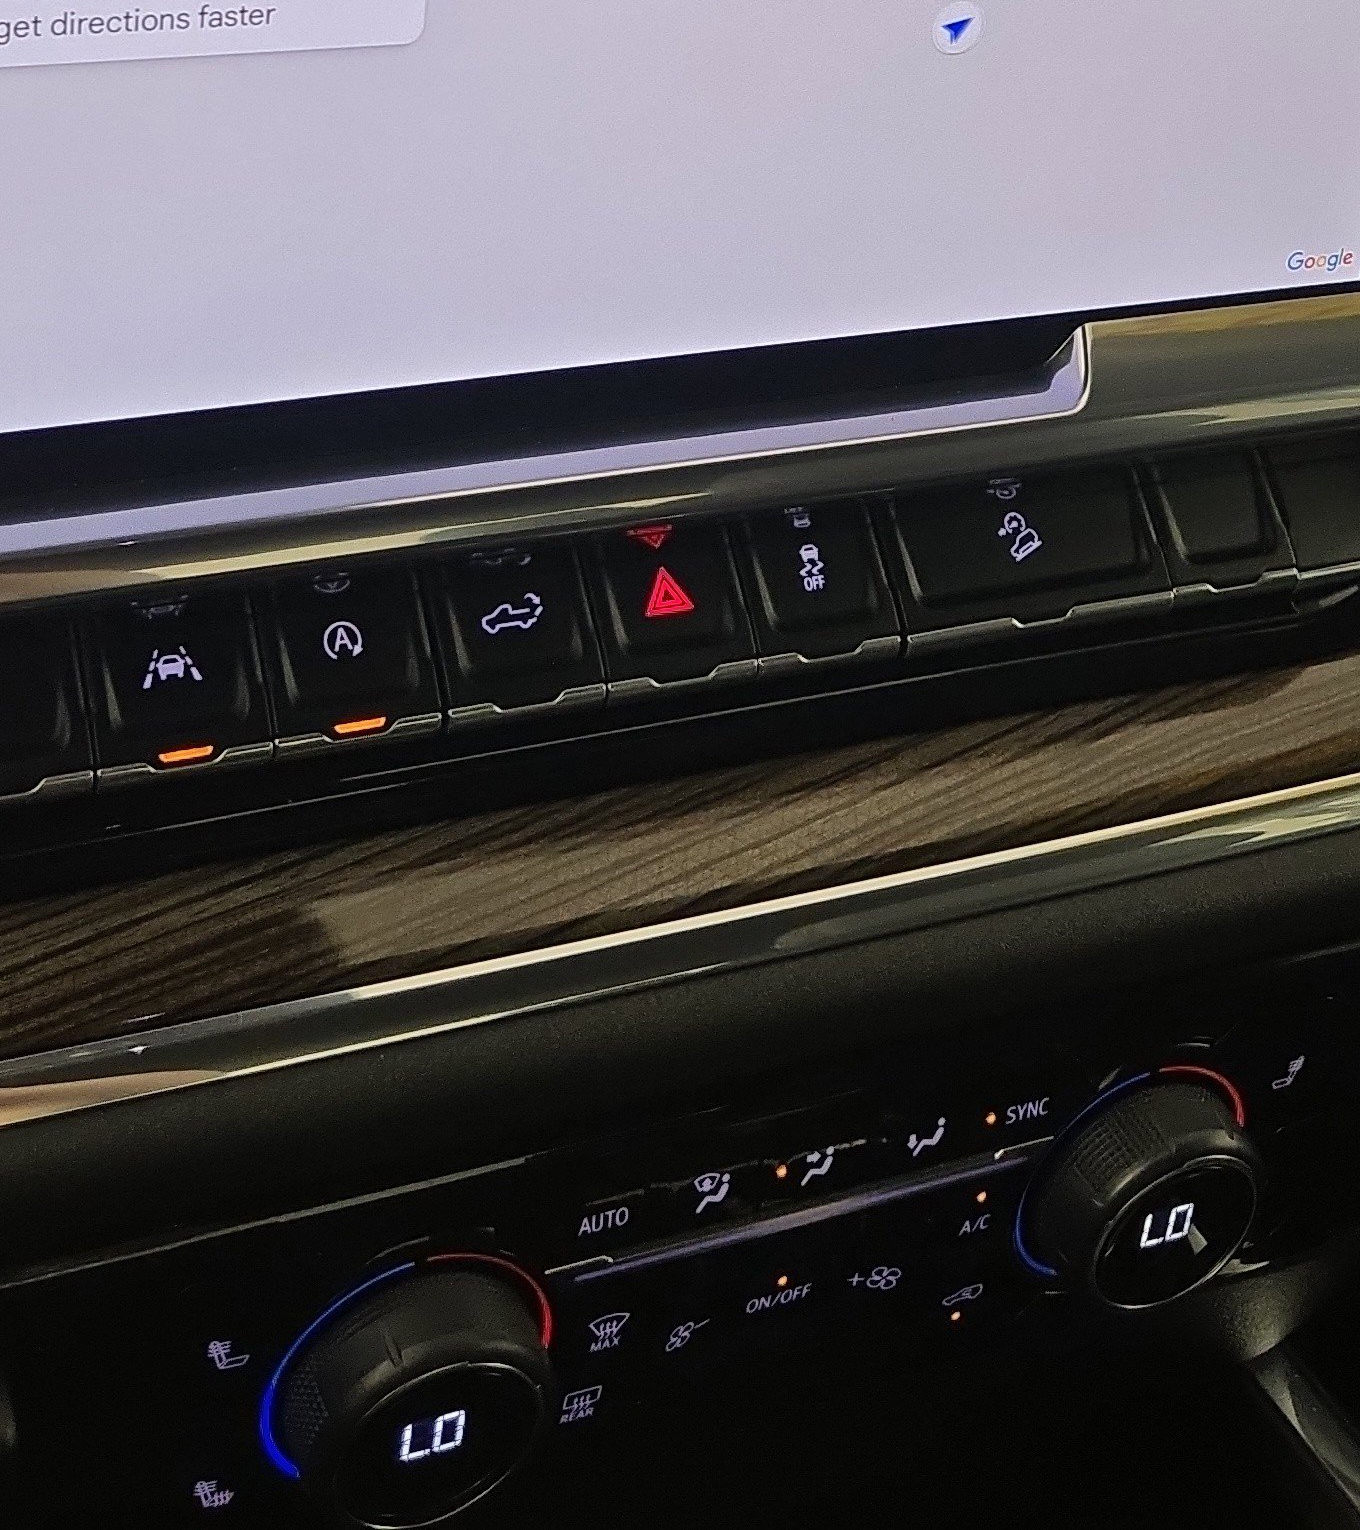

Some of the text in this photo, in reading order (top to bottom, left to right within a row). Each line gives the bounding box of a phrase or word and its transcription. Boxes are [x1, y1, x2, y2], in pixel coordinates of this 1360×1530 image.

[50, 8, 190, 37] directions
[198, 2, 277, 30] faster
[1287, 248, 1353, 271] Google
[803, 575, 826, 592] OFF
[1005, 1098, 1050, 1124] SYNC
[578, 1207, 629, 1236] AUTO
[958, 1213, 990, 1236] A/C
[745, 1282, 812, 1314] ON/OFF
[590, 1337, 621, 1352] MAX
[560, 1406, 593, 1424] REAR
